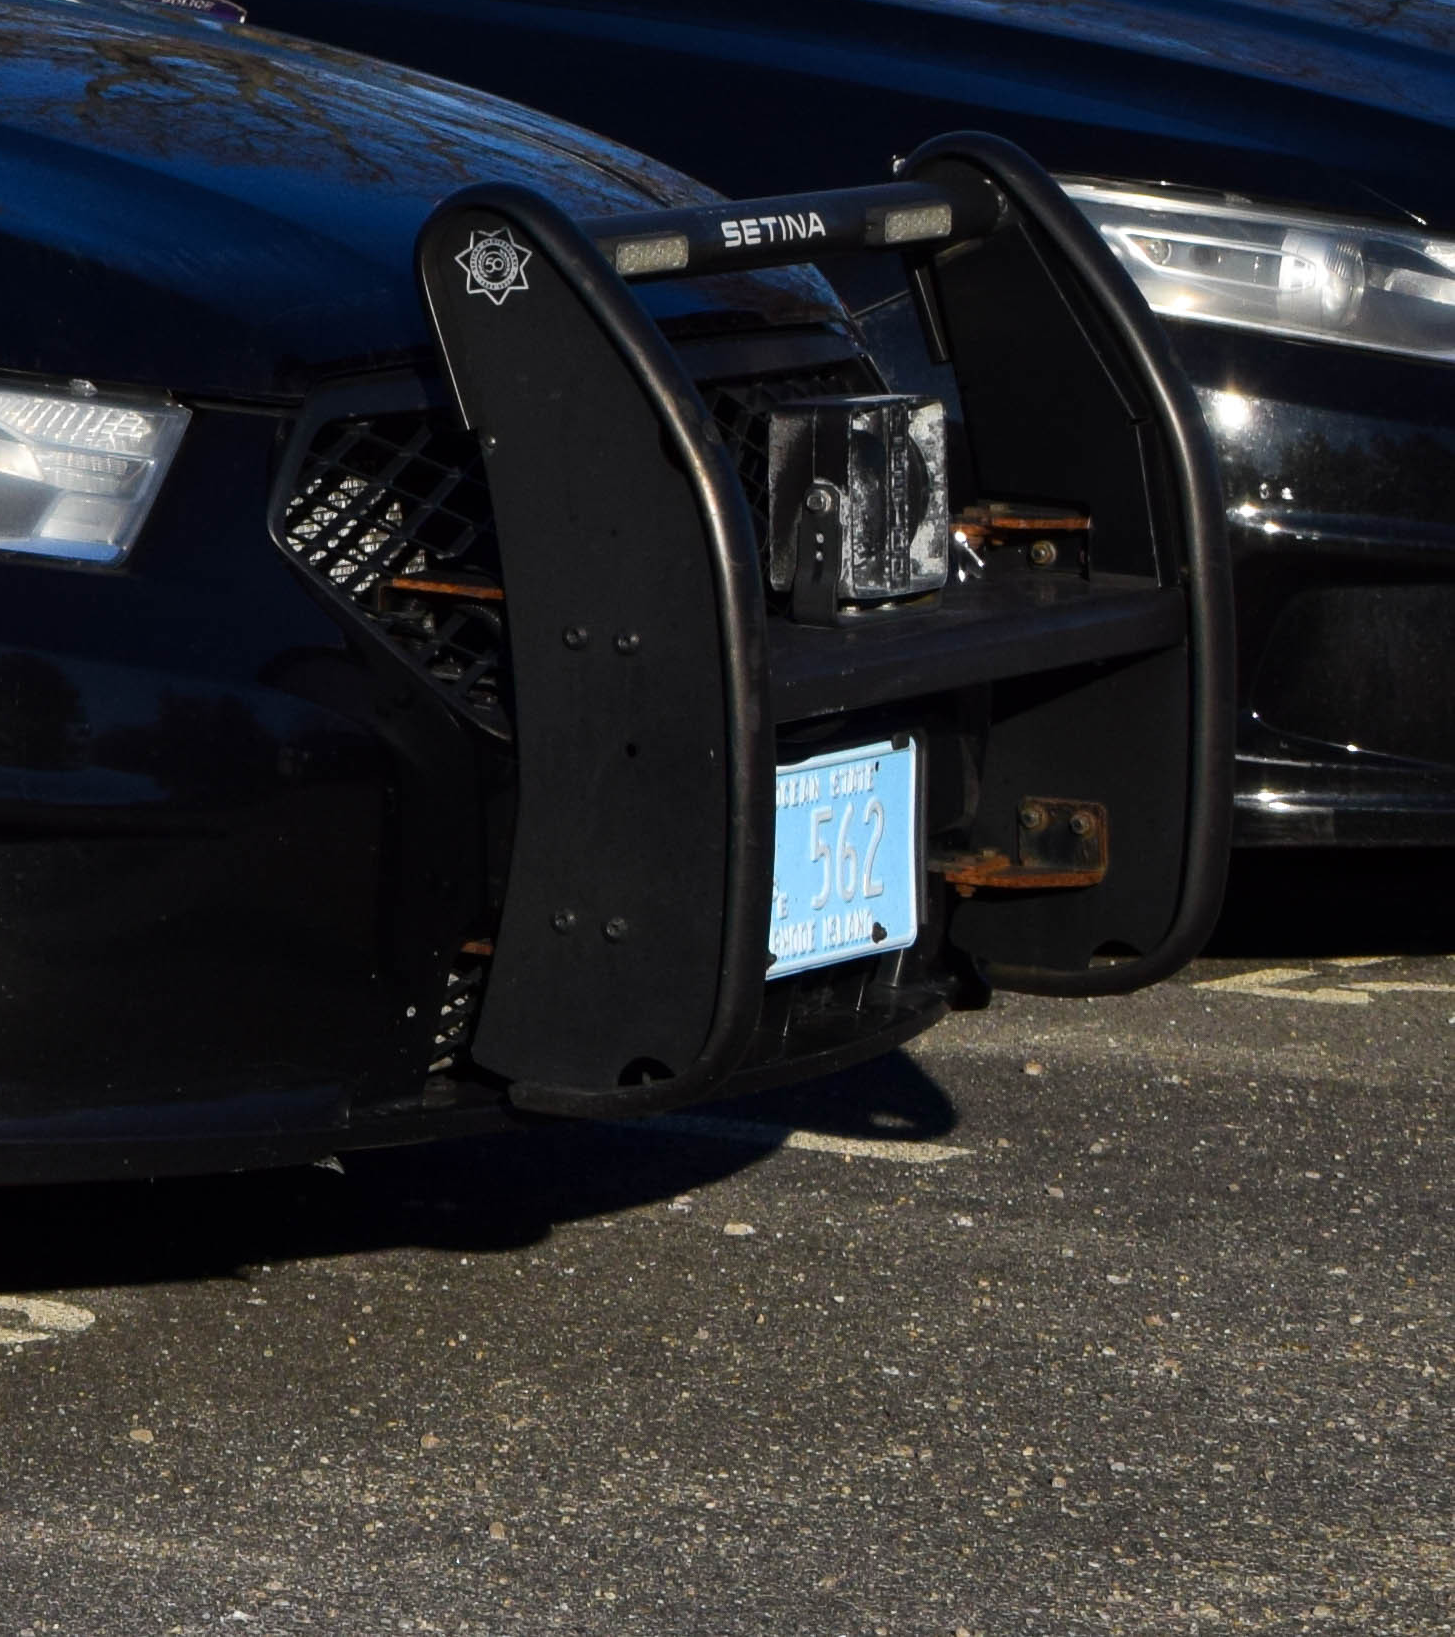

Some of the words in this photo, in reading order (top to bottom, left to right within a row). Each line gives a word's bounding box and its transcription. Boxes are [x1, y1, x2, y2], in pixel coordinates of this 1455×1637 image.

[721, 212, 826, 247] SETINA
[485, 256, 505, 273] 50
[810, 795, 884, 910] 562
